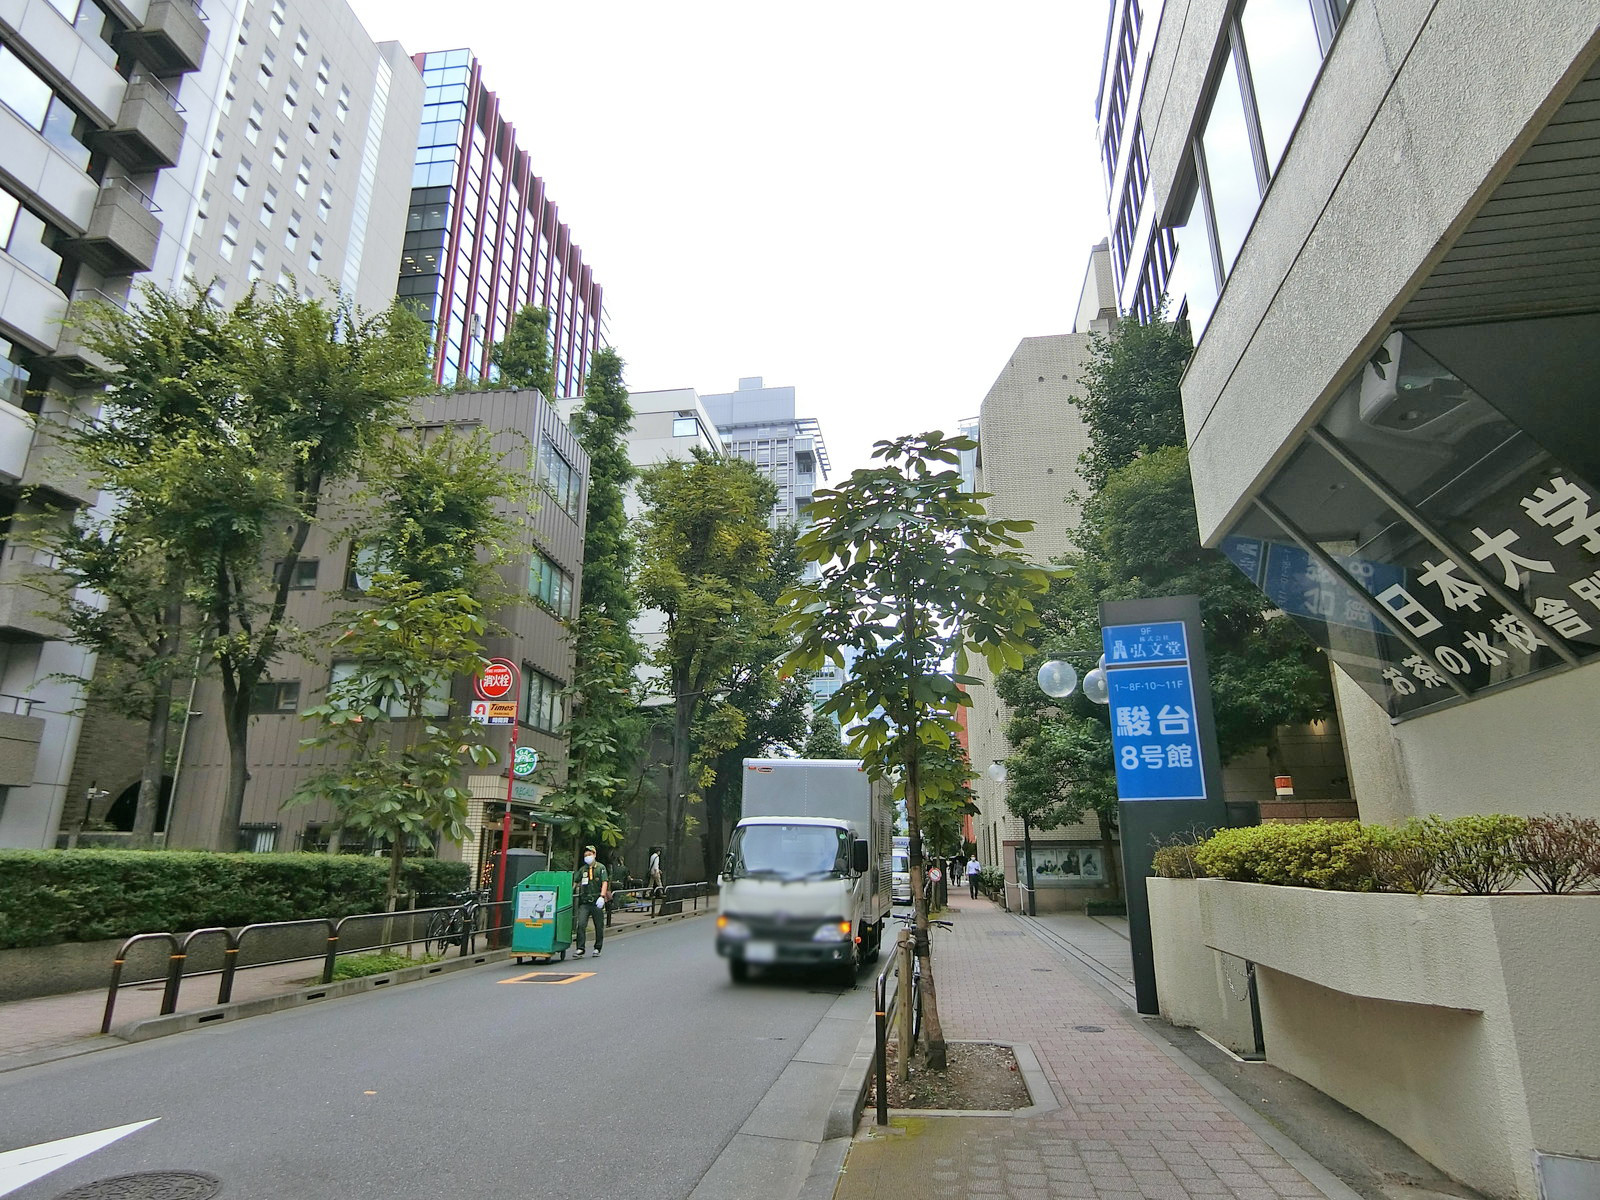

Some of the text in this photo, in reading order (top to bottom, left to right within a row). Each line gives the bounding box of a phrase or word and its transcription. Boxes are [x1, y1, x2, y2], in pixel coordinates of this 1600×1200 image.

[1140, 627, 1152, 635] 9F
[1130, 641, 1183, 659] 弘文堂
[483, 674, 510, 687] 消火栓
[490, 703, 515, 711] Times
[1116, 704, 1190, 737] 駿台
[1121, 743, 1193, 770] 8号館
